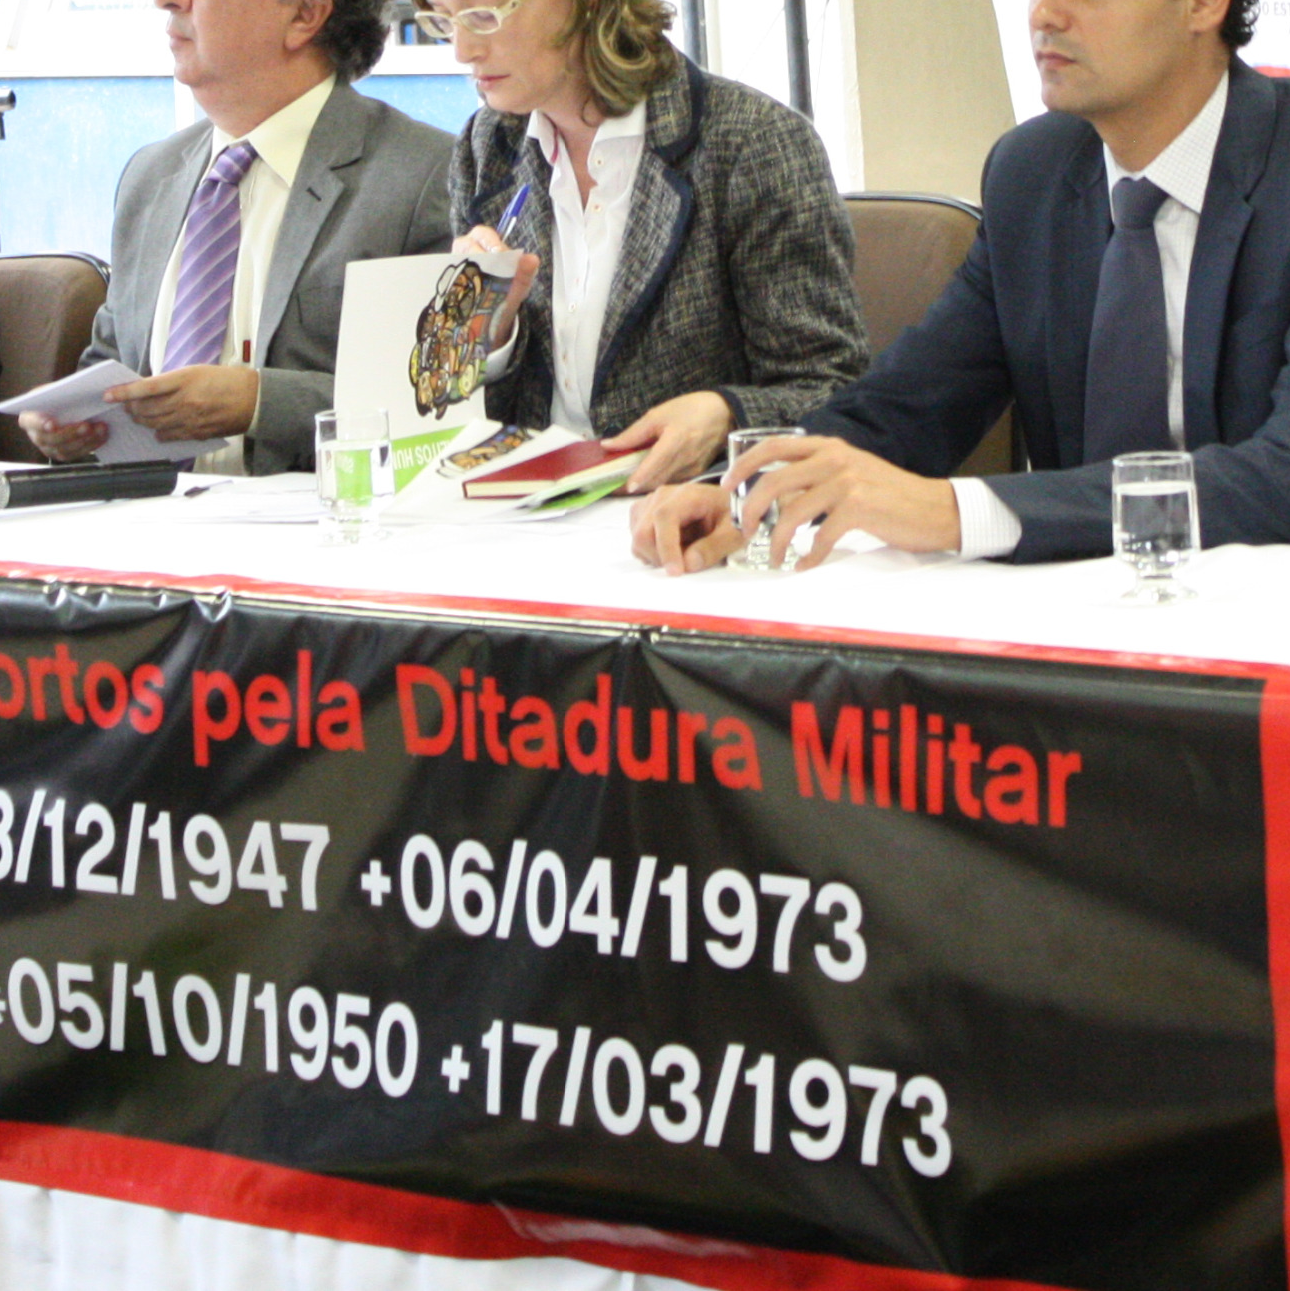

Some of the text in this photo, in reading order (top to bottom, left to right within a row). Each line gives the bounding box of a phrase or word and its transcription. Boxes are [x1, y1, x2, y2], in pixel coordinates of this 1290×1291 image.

[192, 649, 365, 766] pela
[395, 665, 763, 794] Ditadura
[790, 700, 1081, 829] Militar
